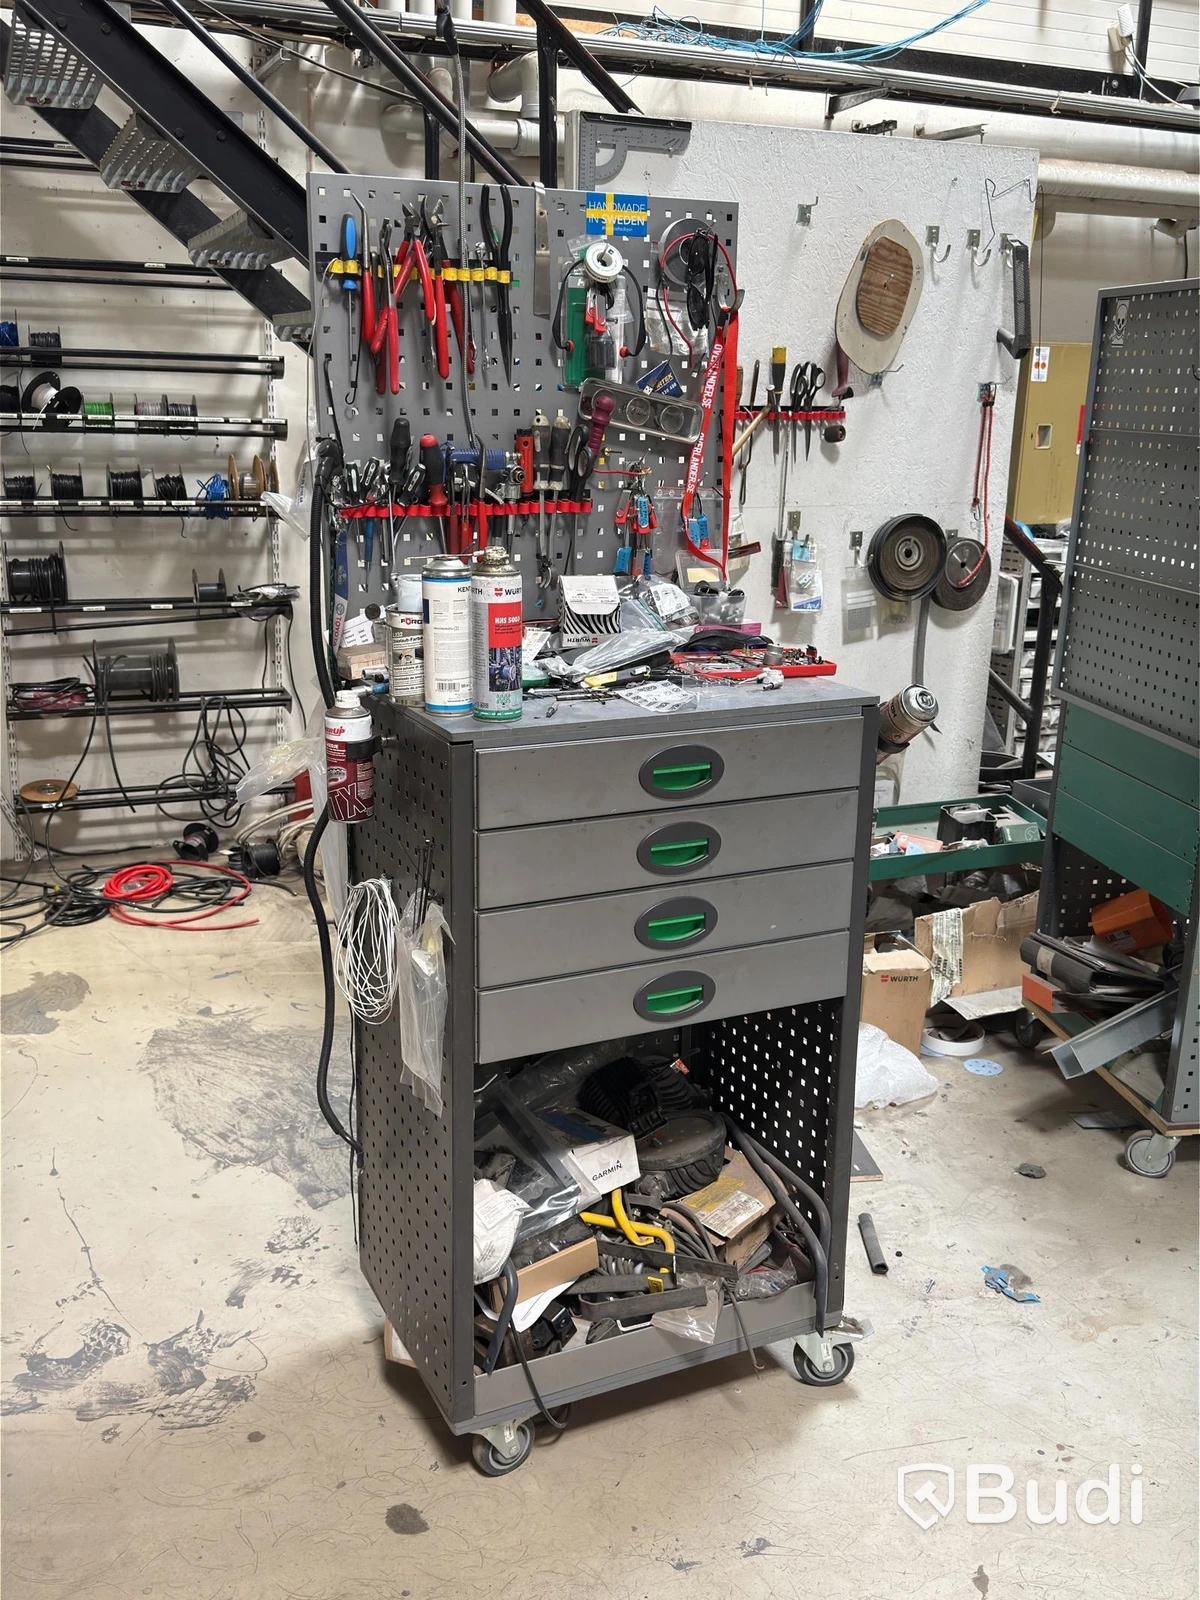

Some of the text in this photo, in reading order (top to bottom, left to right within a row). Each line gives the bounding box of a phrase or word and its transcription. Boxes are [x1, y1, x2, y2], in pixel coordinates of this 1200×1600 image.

[588, 213, 645, 226] IN SWEDEN
[332, 616, 343, 647] TOYOTA
[591, 1162, 623, 1182] GARMIN
